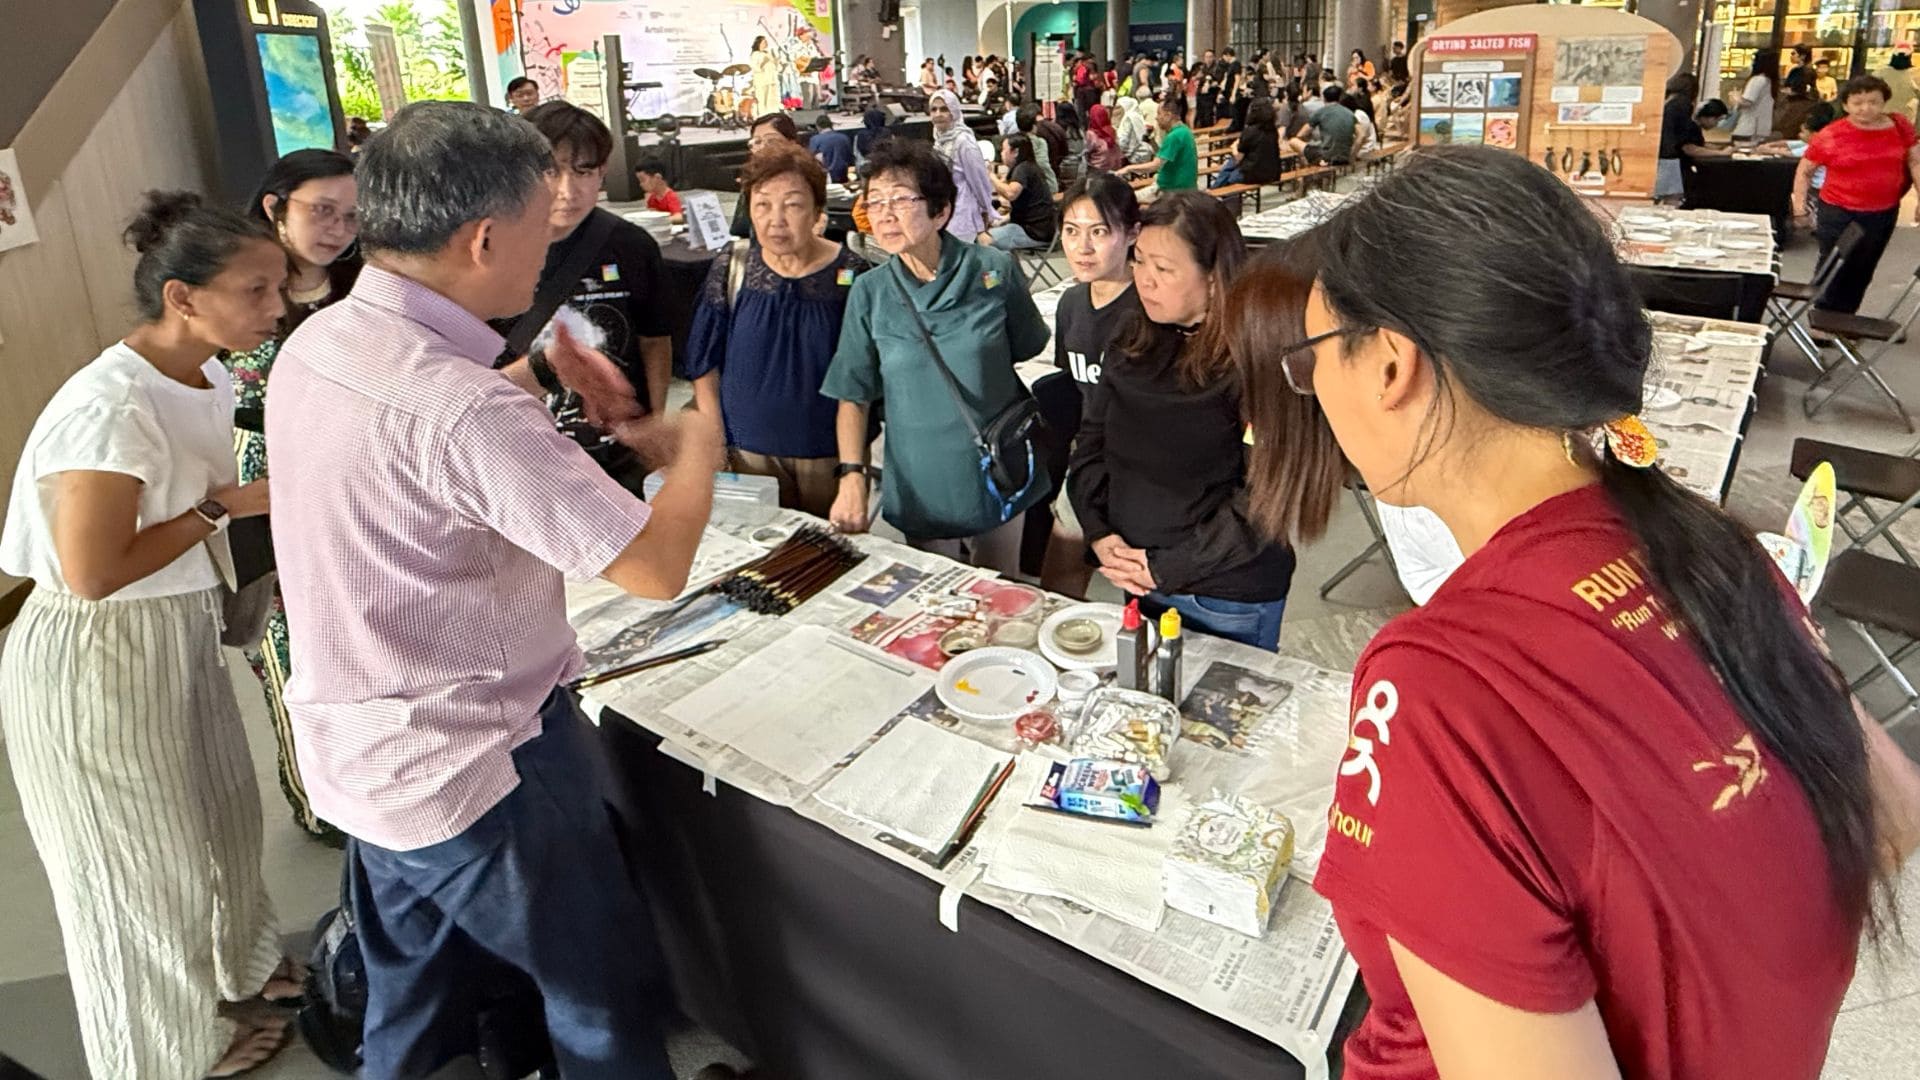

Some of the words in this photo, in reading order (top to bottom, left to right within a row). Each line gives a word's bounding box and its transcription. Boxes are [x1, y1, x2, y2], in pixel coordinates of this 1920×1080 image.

[1469, 38, 1506, 49] SALTED
[1508, 37, 1532, 49] FISH
[1570, 557, 1645, 612] RUN
